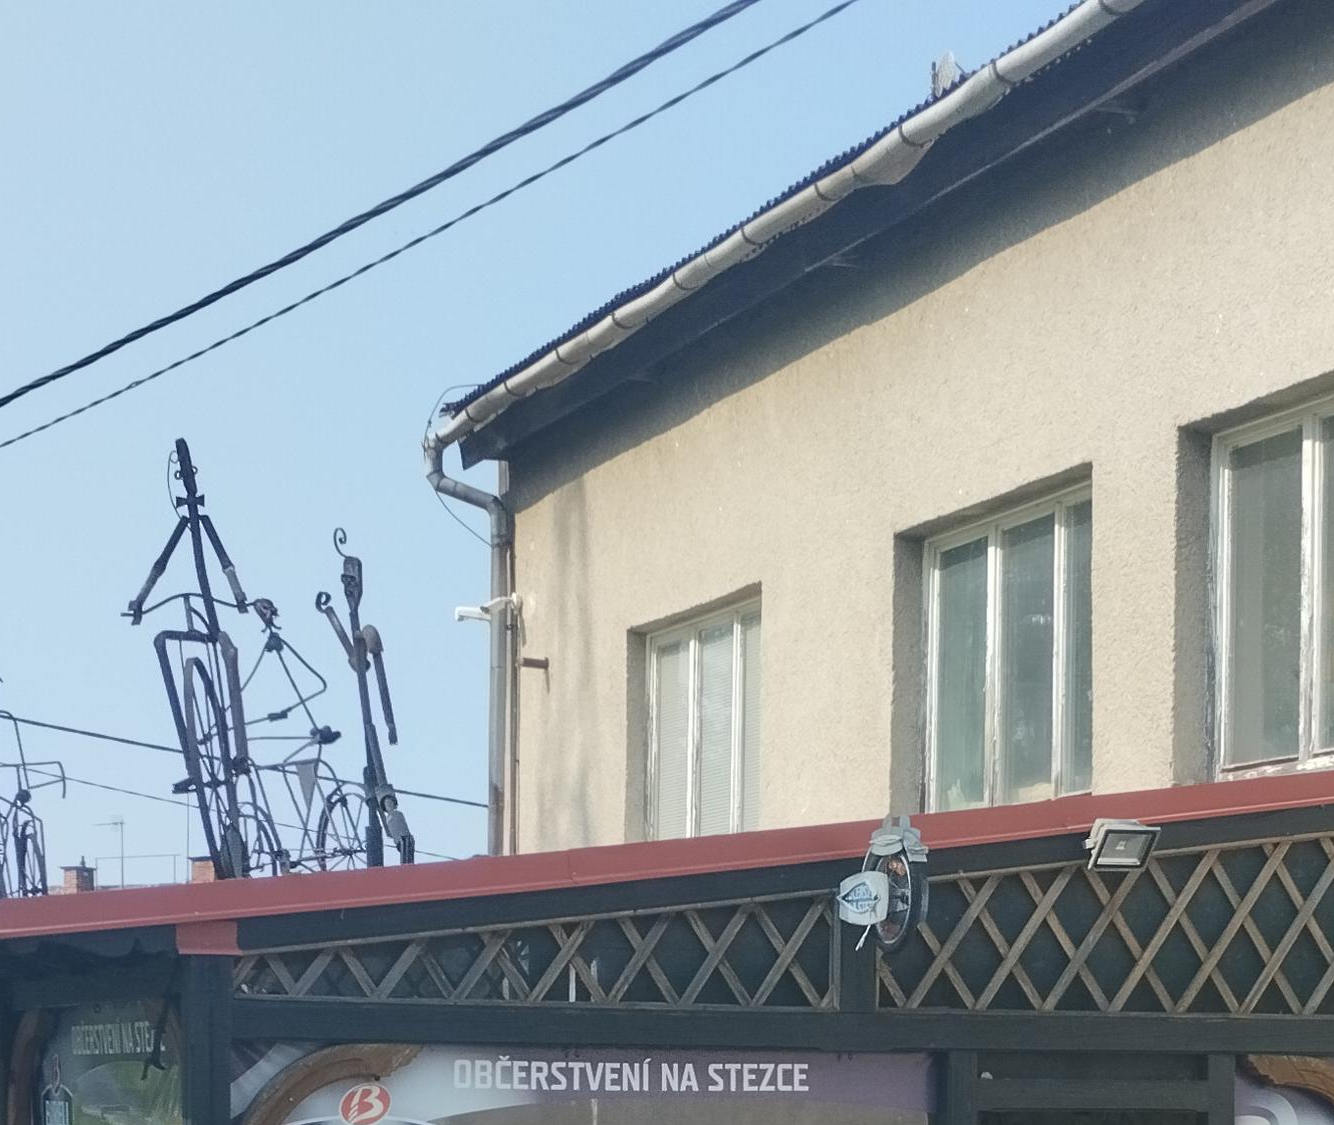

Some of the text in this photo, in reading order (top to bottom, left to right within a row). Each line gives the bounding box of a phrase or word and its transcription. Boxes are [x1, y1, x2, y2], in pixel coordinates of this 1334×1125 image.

[453, 1055, 809, 1092] OBČERSTVENÍ NA STEZCE
